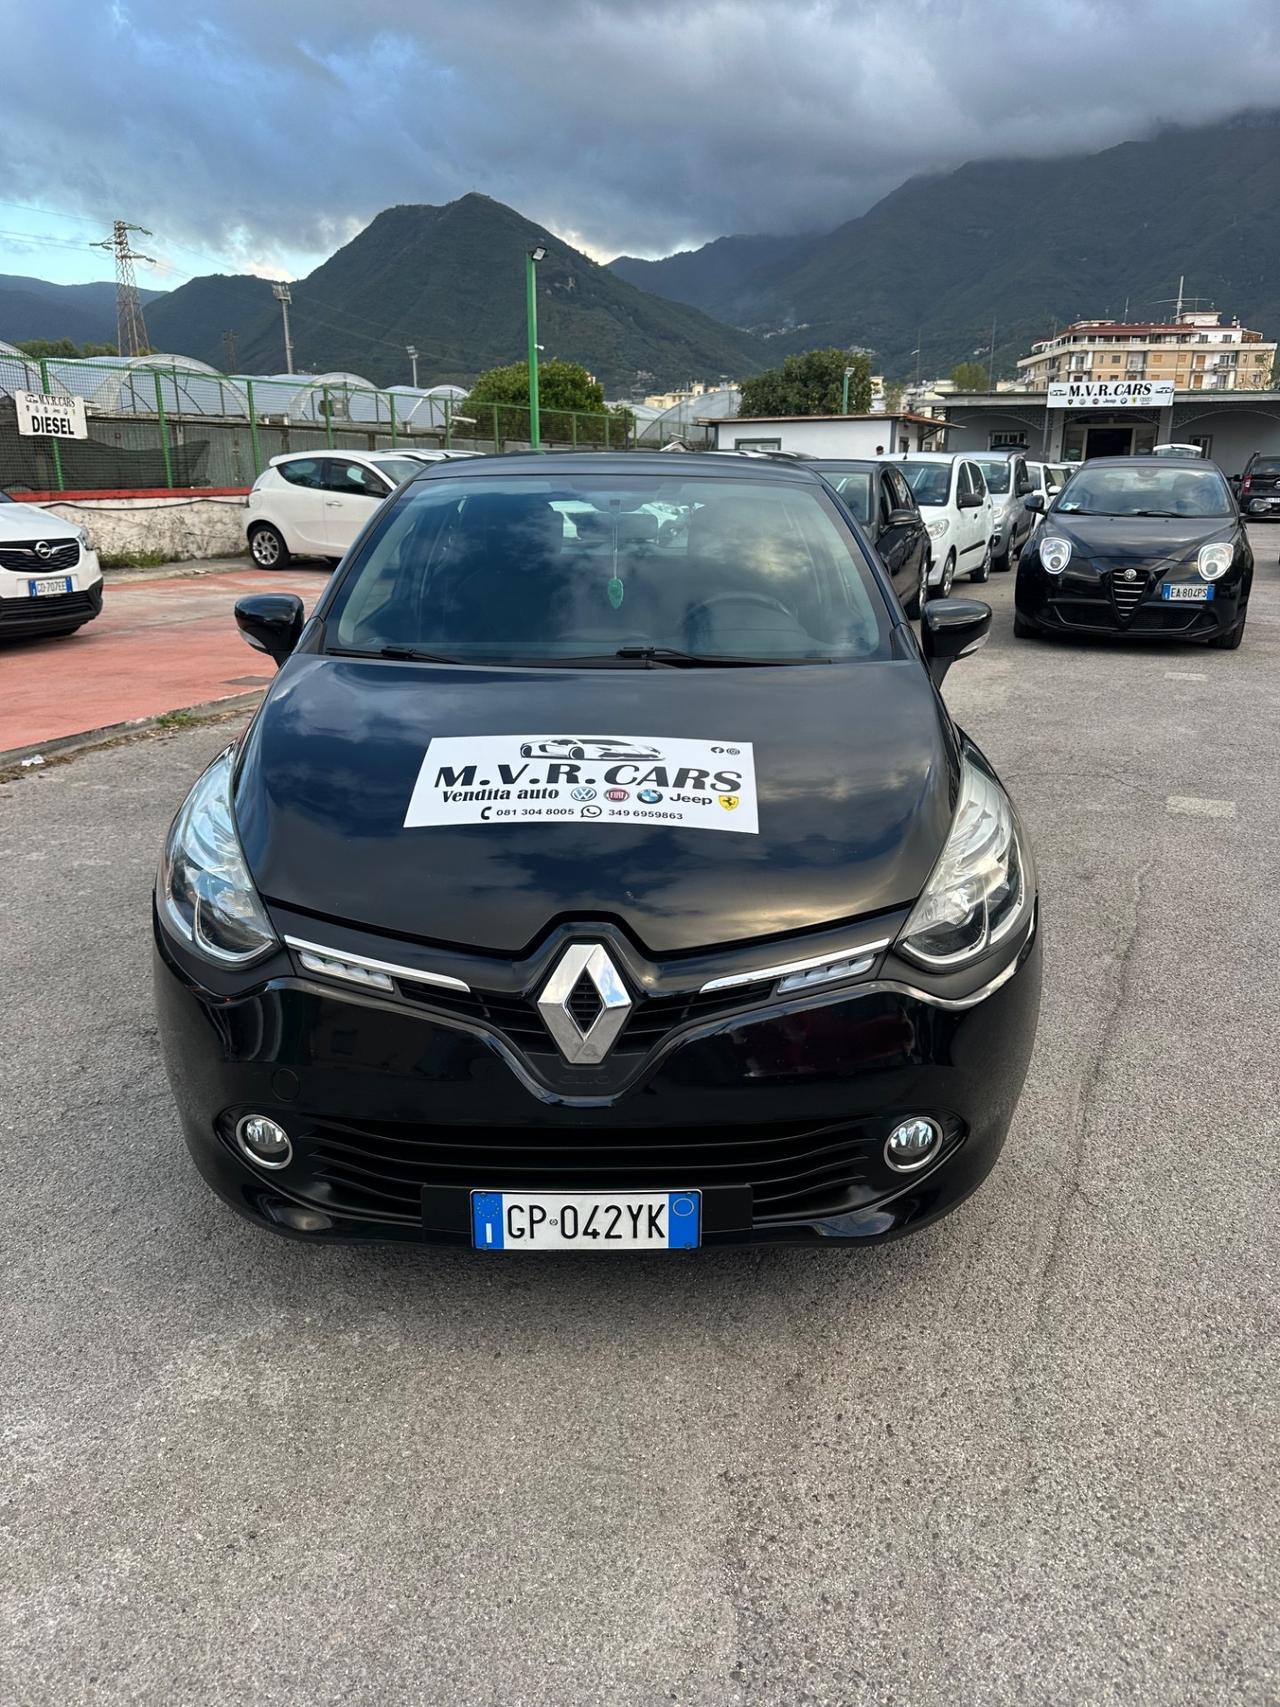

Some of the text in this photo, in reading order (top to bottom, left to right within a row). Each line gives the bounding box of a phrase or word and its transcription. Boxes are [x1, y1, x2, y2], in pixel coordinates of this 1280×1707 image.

[31, 415, 74, 435] DIESEL
[442, 787, 559, 802] Vendita auto
[669, 793, 713, 805] Jeep
[496, 808, 575, 816] 081 304 8005
[608, 808, 684, 820] 349 6959863
